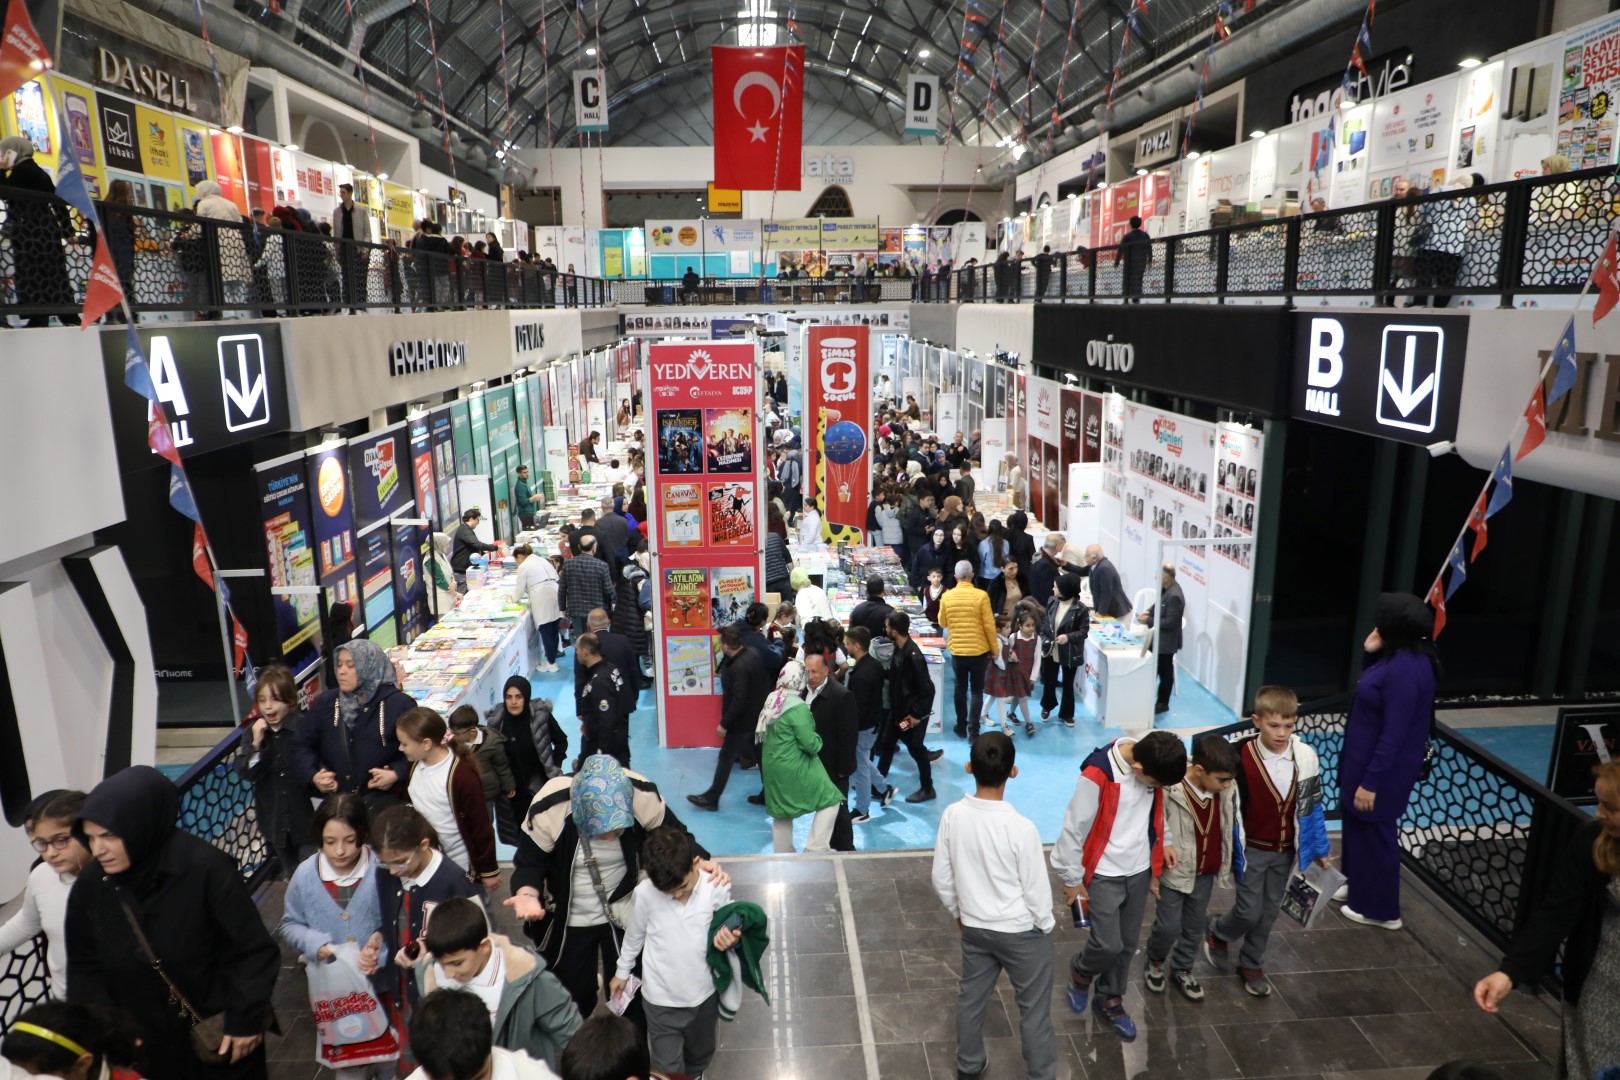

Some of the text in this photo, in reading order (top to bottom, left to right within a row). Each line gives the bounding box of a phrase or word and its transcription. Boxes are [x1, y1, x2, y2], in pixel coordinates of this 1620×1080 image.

[1583, 46, 1620, 73] ŞEYLE
[99, 47, 197, 112] DASELL
[581, 77, 599, 108] C
[913, 82, 931, 111] D
[1592, 94, 1606, 112] 23
[584, 112, 599, 120] HALL
[108, 145, 134, 160] ithaki
[388, 337, 447, 376] AYHAN
[1308, 318, 1345, 388] B
[148, 336, 190, 421] A
[823, 392, 856, 402] ÇOCUK
[1305, 389, 1341, 417] HALL
[1159, 418, 1176, 432] Kitap
[1158, 430, 1183, 446] günleri
[668, 574, 704, 584] SAYILARIN
[674, 582, 699, 592] İZİNDE
